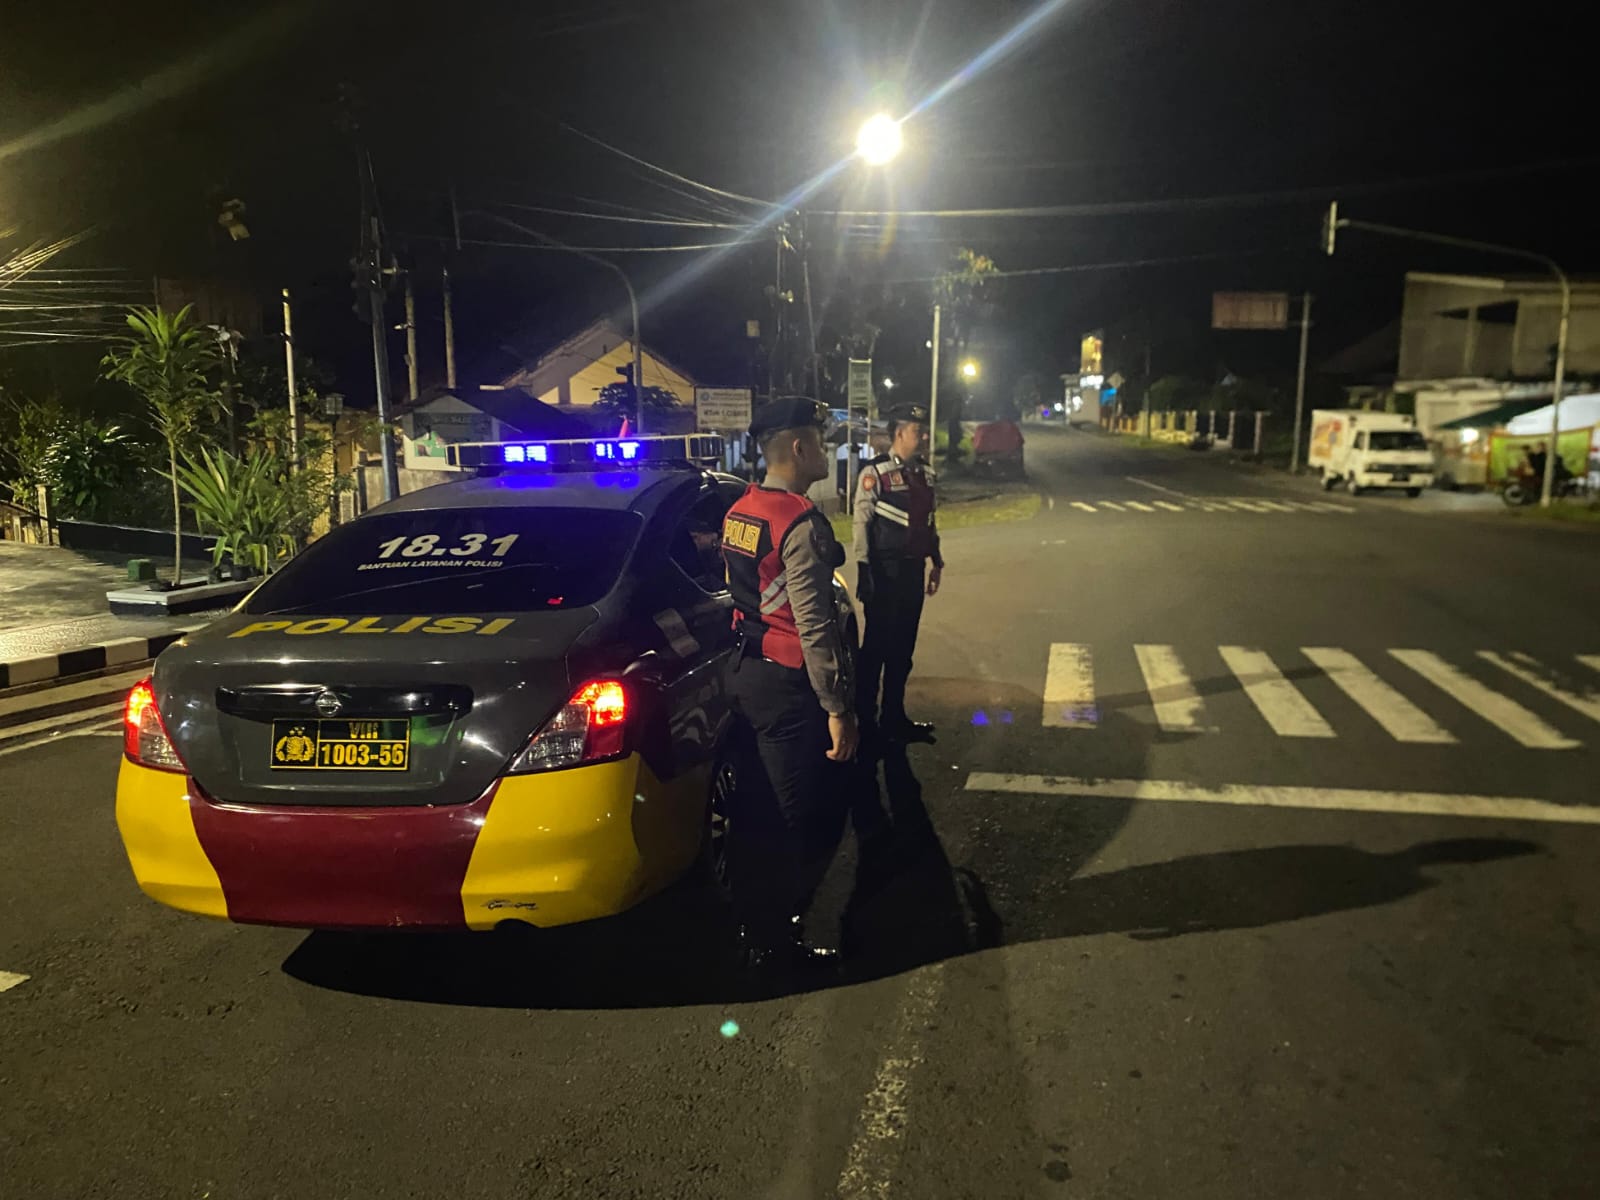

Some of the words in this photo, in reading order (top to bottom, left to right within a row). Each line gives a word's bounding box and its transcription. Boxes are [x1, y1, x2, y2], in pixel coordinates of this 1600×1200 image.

[378, 533, 519, 558] 18.31
[723, 519, 760, 553] POLISI
[357, 561, 410, 571] BANTUAN
[411, 560, 463, 568] LAYANAN
[227, 616, 515, 638] POLISI
[321, 743, 405, 766] 1003-56
